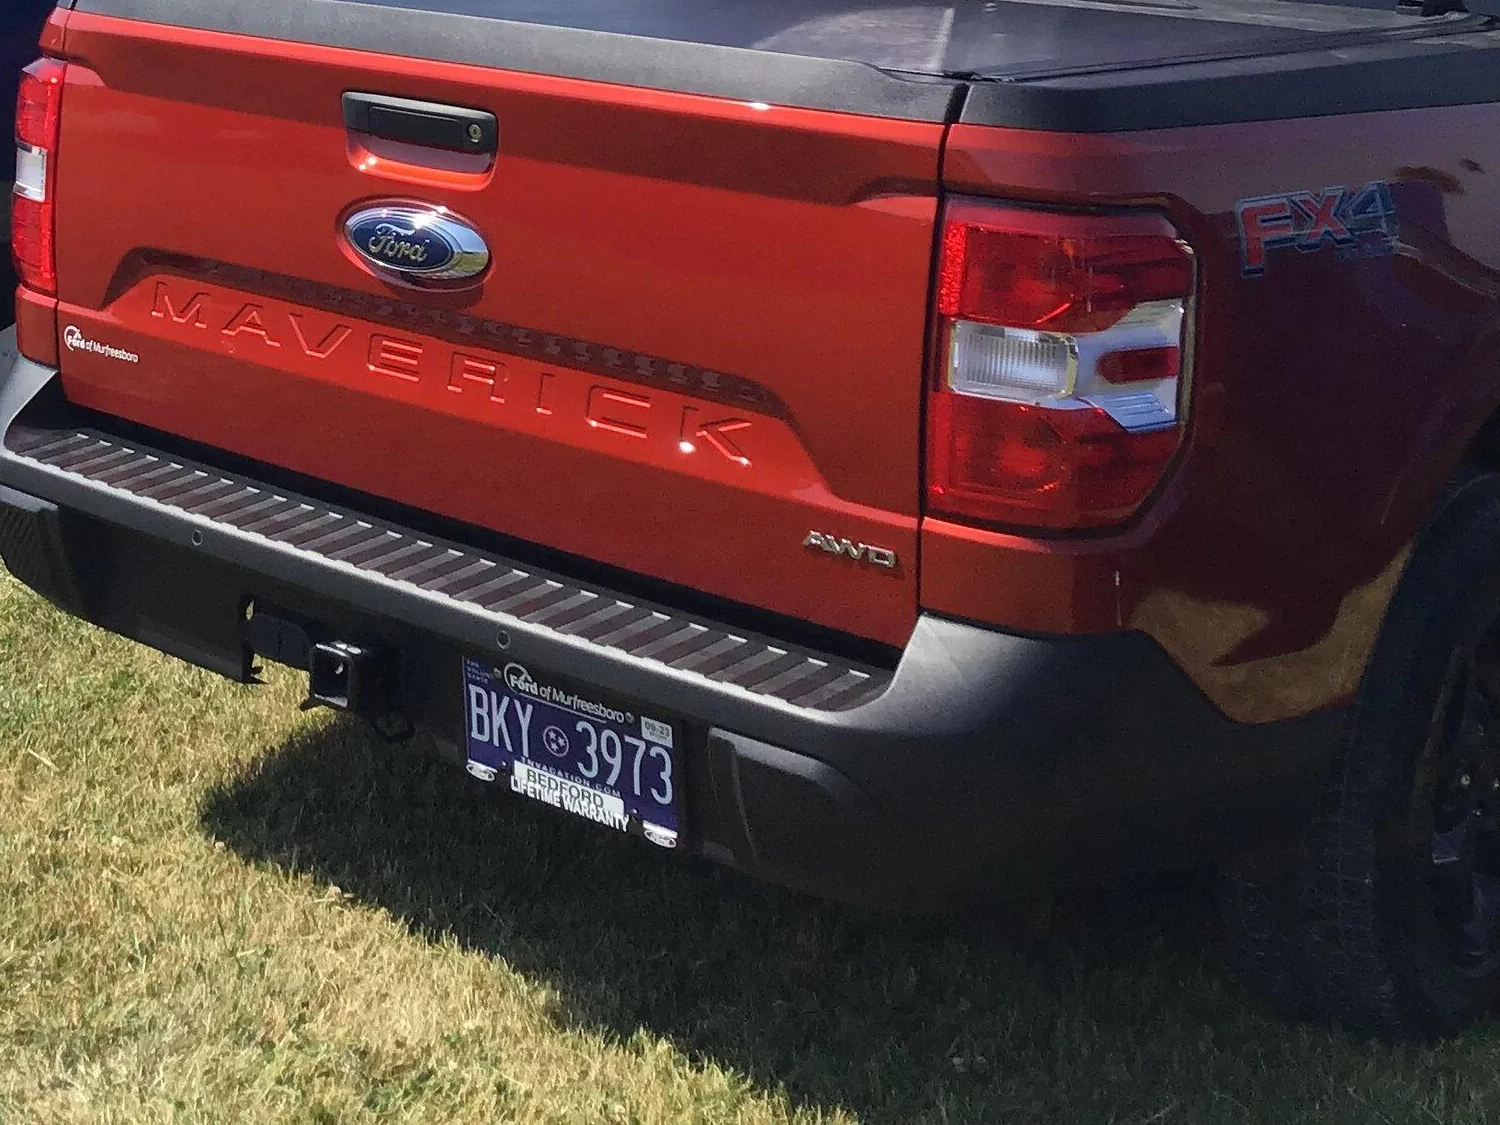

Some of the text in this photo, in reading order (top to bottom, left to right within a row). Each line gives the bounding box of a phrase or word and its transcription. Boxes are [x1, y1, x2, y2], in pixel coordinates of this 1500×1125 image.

[368, 222, 431, 263] Ford
[1235, 180, 1397, 279] FX4
[67, 334, 140, 364] Ford of Murfreesboro
[151, 280, 753, 467] MAVERICK
[802, 529, 897, 569] AWD
[509, 673, 625, 724] Ford of Murfreesboro
[468, 683, 674, 805] BKY 3973
[510, 775, 562, 809] LIFETIME
[526, 768, 605, 809] BEDFORD
[561, 790, 630, 833] WARRANTY
